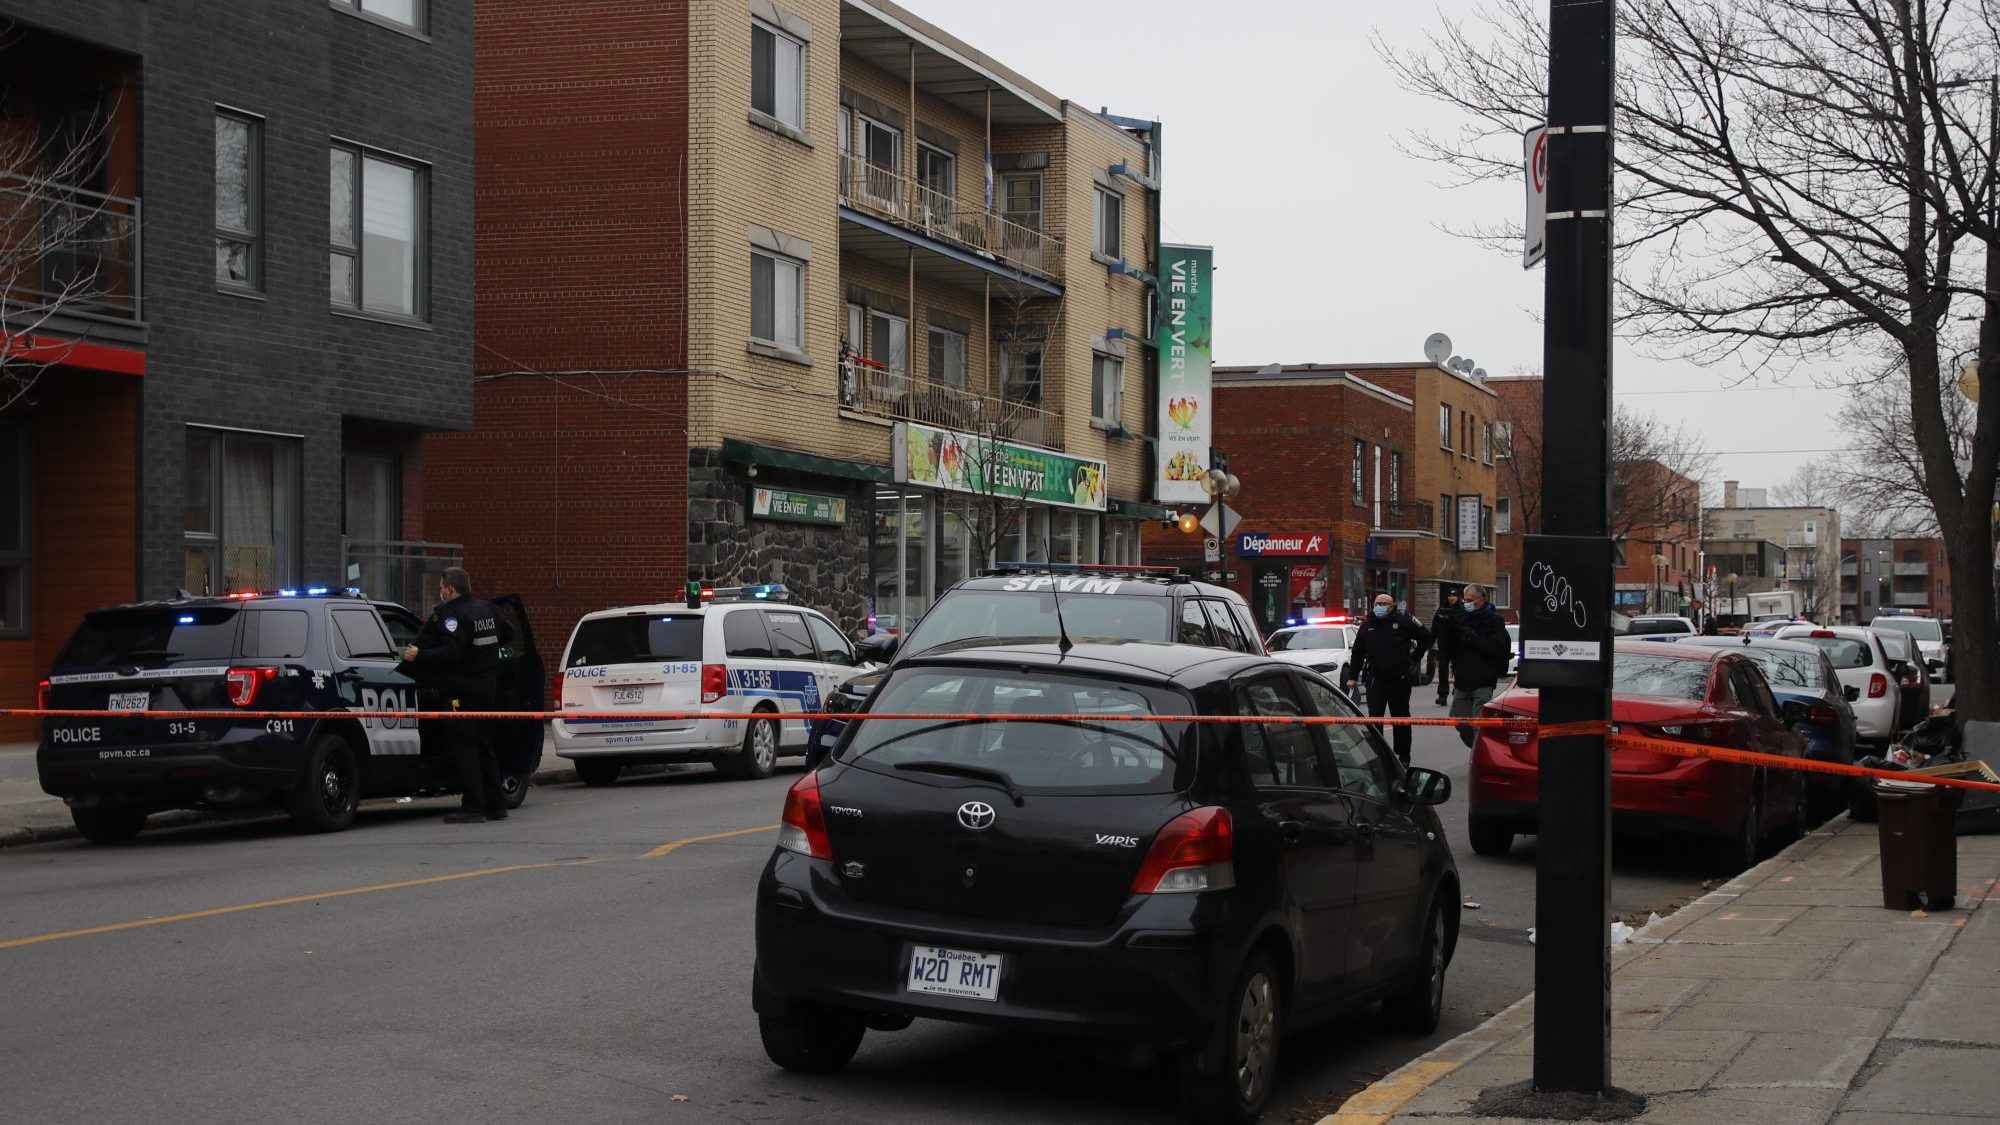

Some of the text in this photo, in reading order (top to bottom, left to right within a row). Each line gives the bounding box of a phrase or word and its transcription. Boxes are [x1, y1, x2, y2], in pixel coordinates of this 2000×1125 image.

[1170, 259, 1186, 382] VIE EN VERT
[983, 463, 1045, 492] VE EN VERT
[773, 500, 783, 513] VIE
[783, 502, 792, 514] EN
[792, 503, 808, 515] VERT
[1243, 535, 1303, 552] Dépanneur
[1003, 576, 1121, 594] SPVM
[566, 666, 608, 679] POLICE
[662, 663, 697, 674] 31-85
[743, 670, 772, 688] 31-85
[169, 721, 196, 735] 31-5
[274, 719, 294, 733] 911
[728, 720, 738, 729] 911
[53, 727, 101, 743] POLICE
[605, 736, 644, 744] spvm.qc.ca
[99, 748, 150, 760] spvm.qc.ca
[830, 806, 863, 817] TOYOTA
[946, 951, 977, 962] Québec
[913, 956, 997, 989] W20 RMT
[948, 988, 976, 996] souviens
